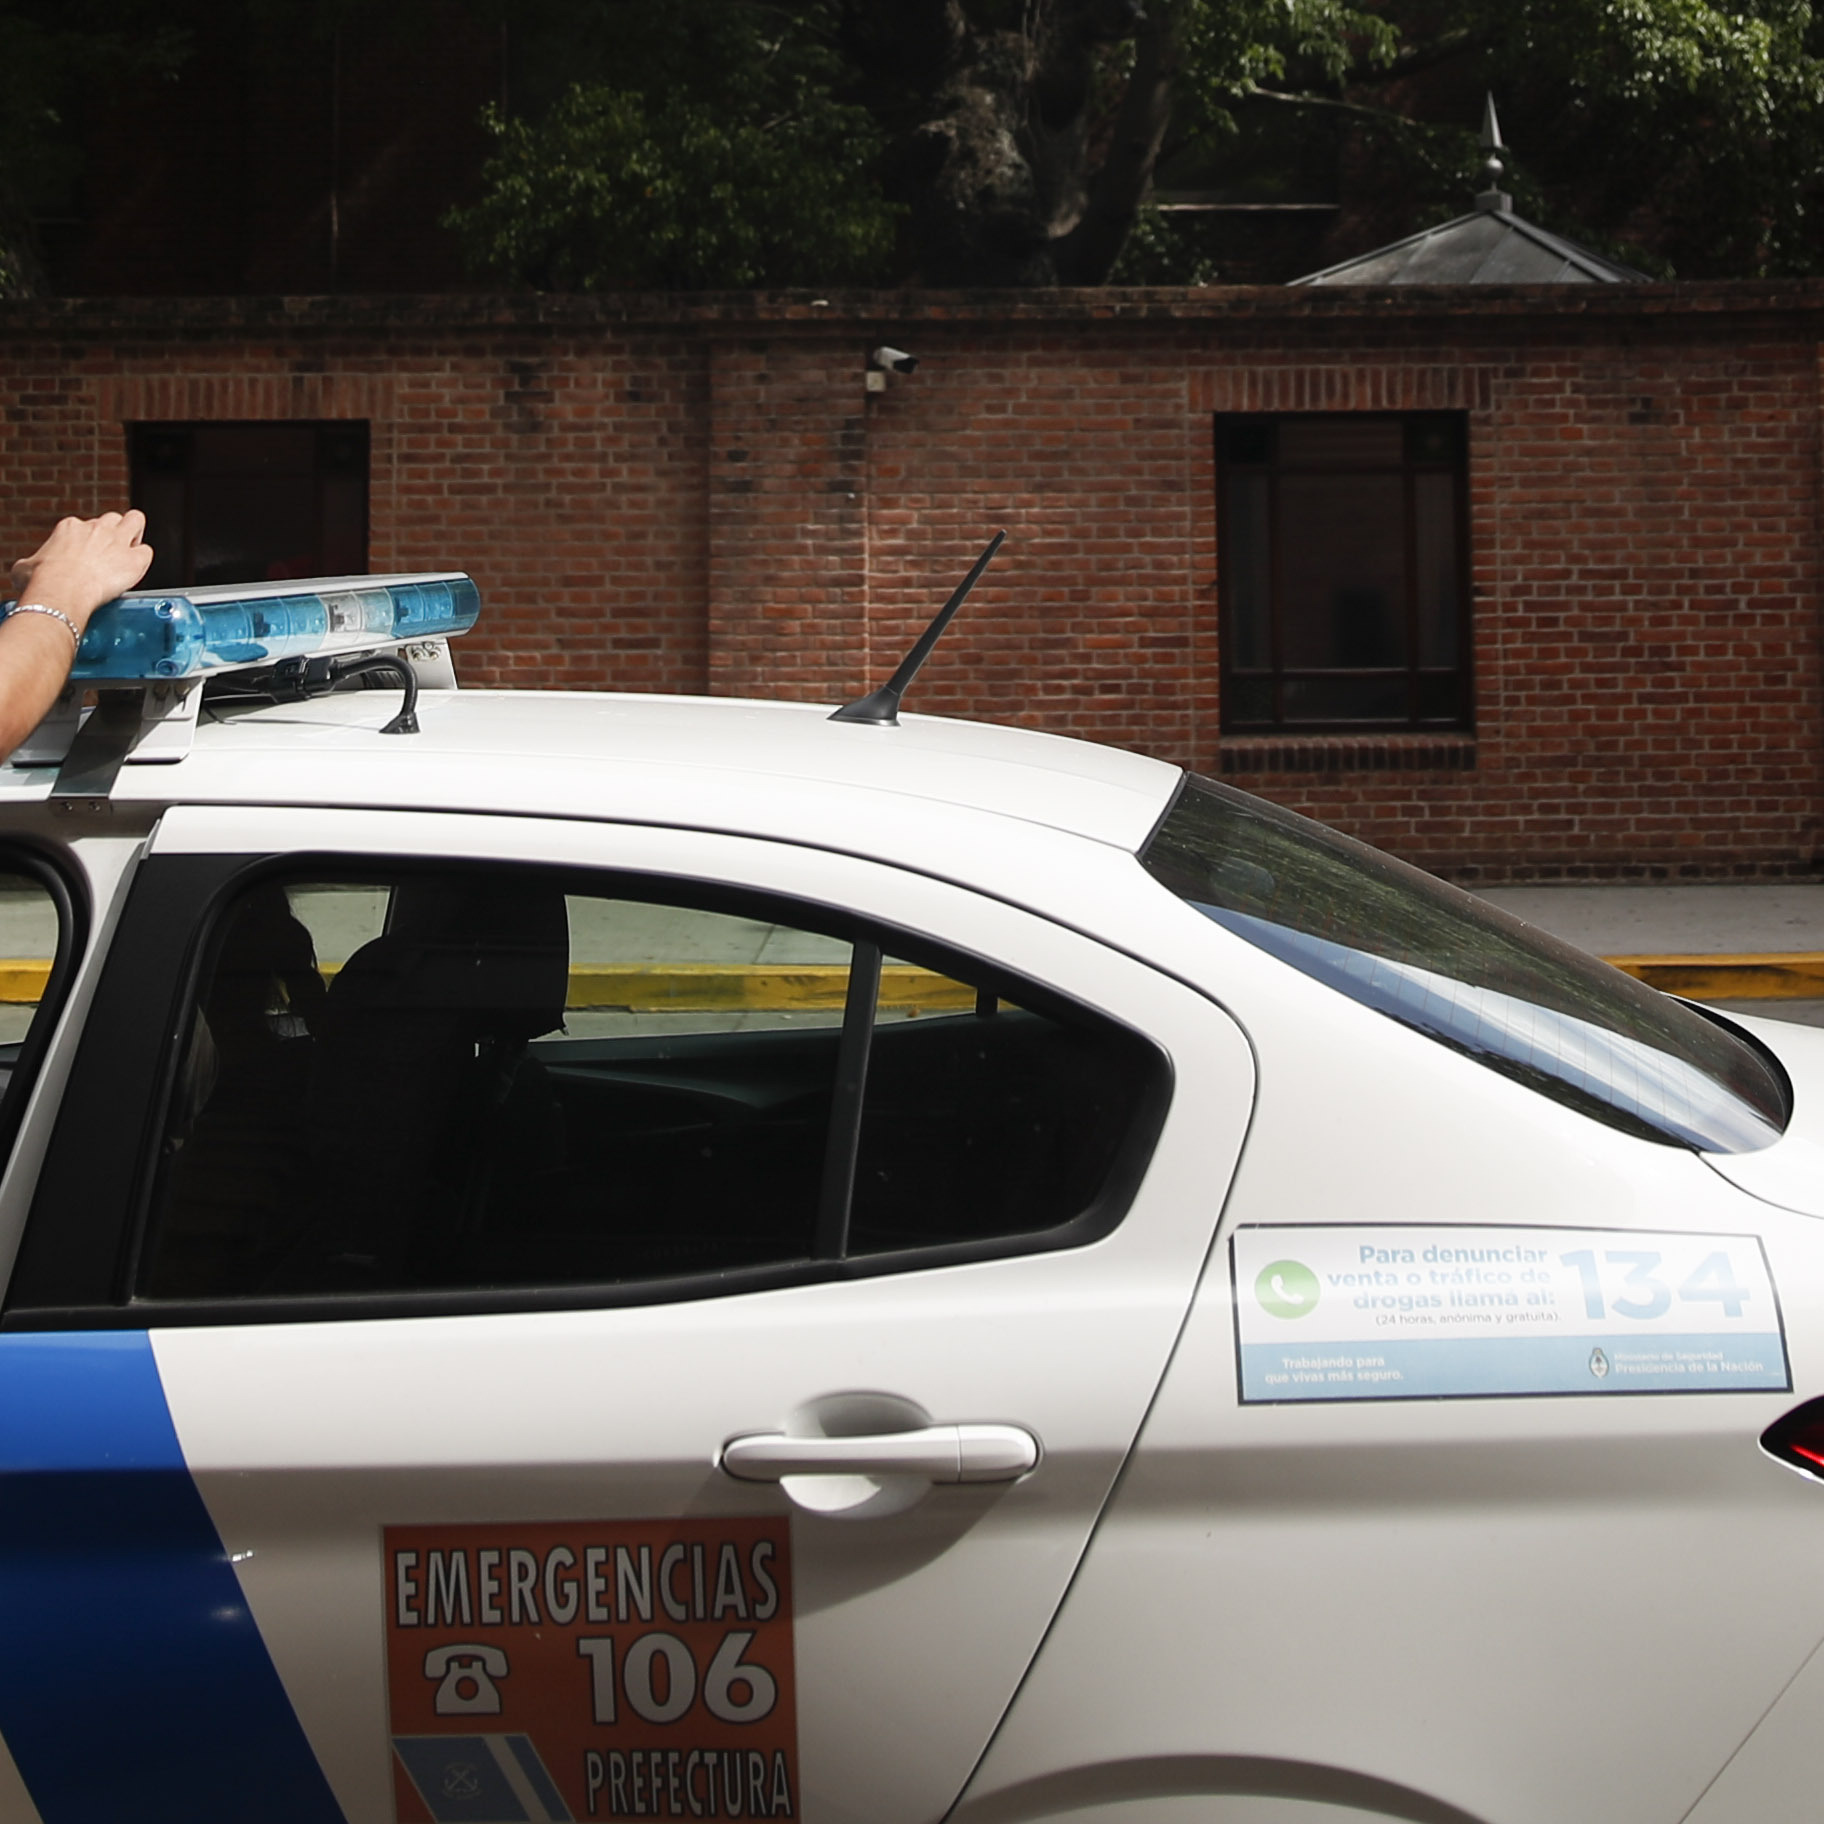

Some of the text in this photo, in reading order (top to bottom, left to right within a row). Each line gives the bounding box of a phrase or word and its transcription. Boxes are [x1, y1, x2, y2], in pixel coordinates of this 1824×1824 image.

[1359, 1244, 1548, 1264] Para denunciar
[1327, 1268, 1551, 1287] venta o tráfico de
[1560, 1249, 1750, 1320] 134
[1353, 1288, 1556, 1312] drogas llamá al:
[1375, 1315, 1396, 1326] (24
[1439, 1312, 1492, 1324] anónima
[1495, 1314, 1503, 1325] y
[1283, 1356, 1385, 1370] Trabajando para
[1615, 1360, 1764, 1374] Presidencia de la Nación
[1265, 1372, 1289, 1384] que
[1293, 1371, 1324, 1382] vivas
[1327, 1370, 1354, 1382] más
[395, 1539, 780, 1628] EMERGENCIAS
[576, 1630, 779, 1725] 106
[584, 1748, 794, 1818] PREFECTURA
